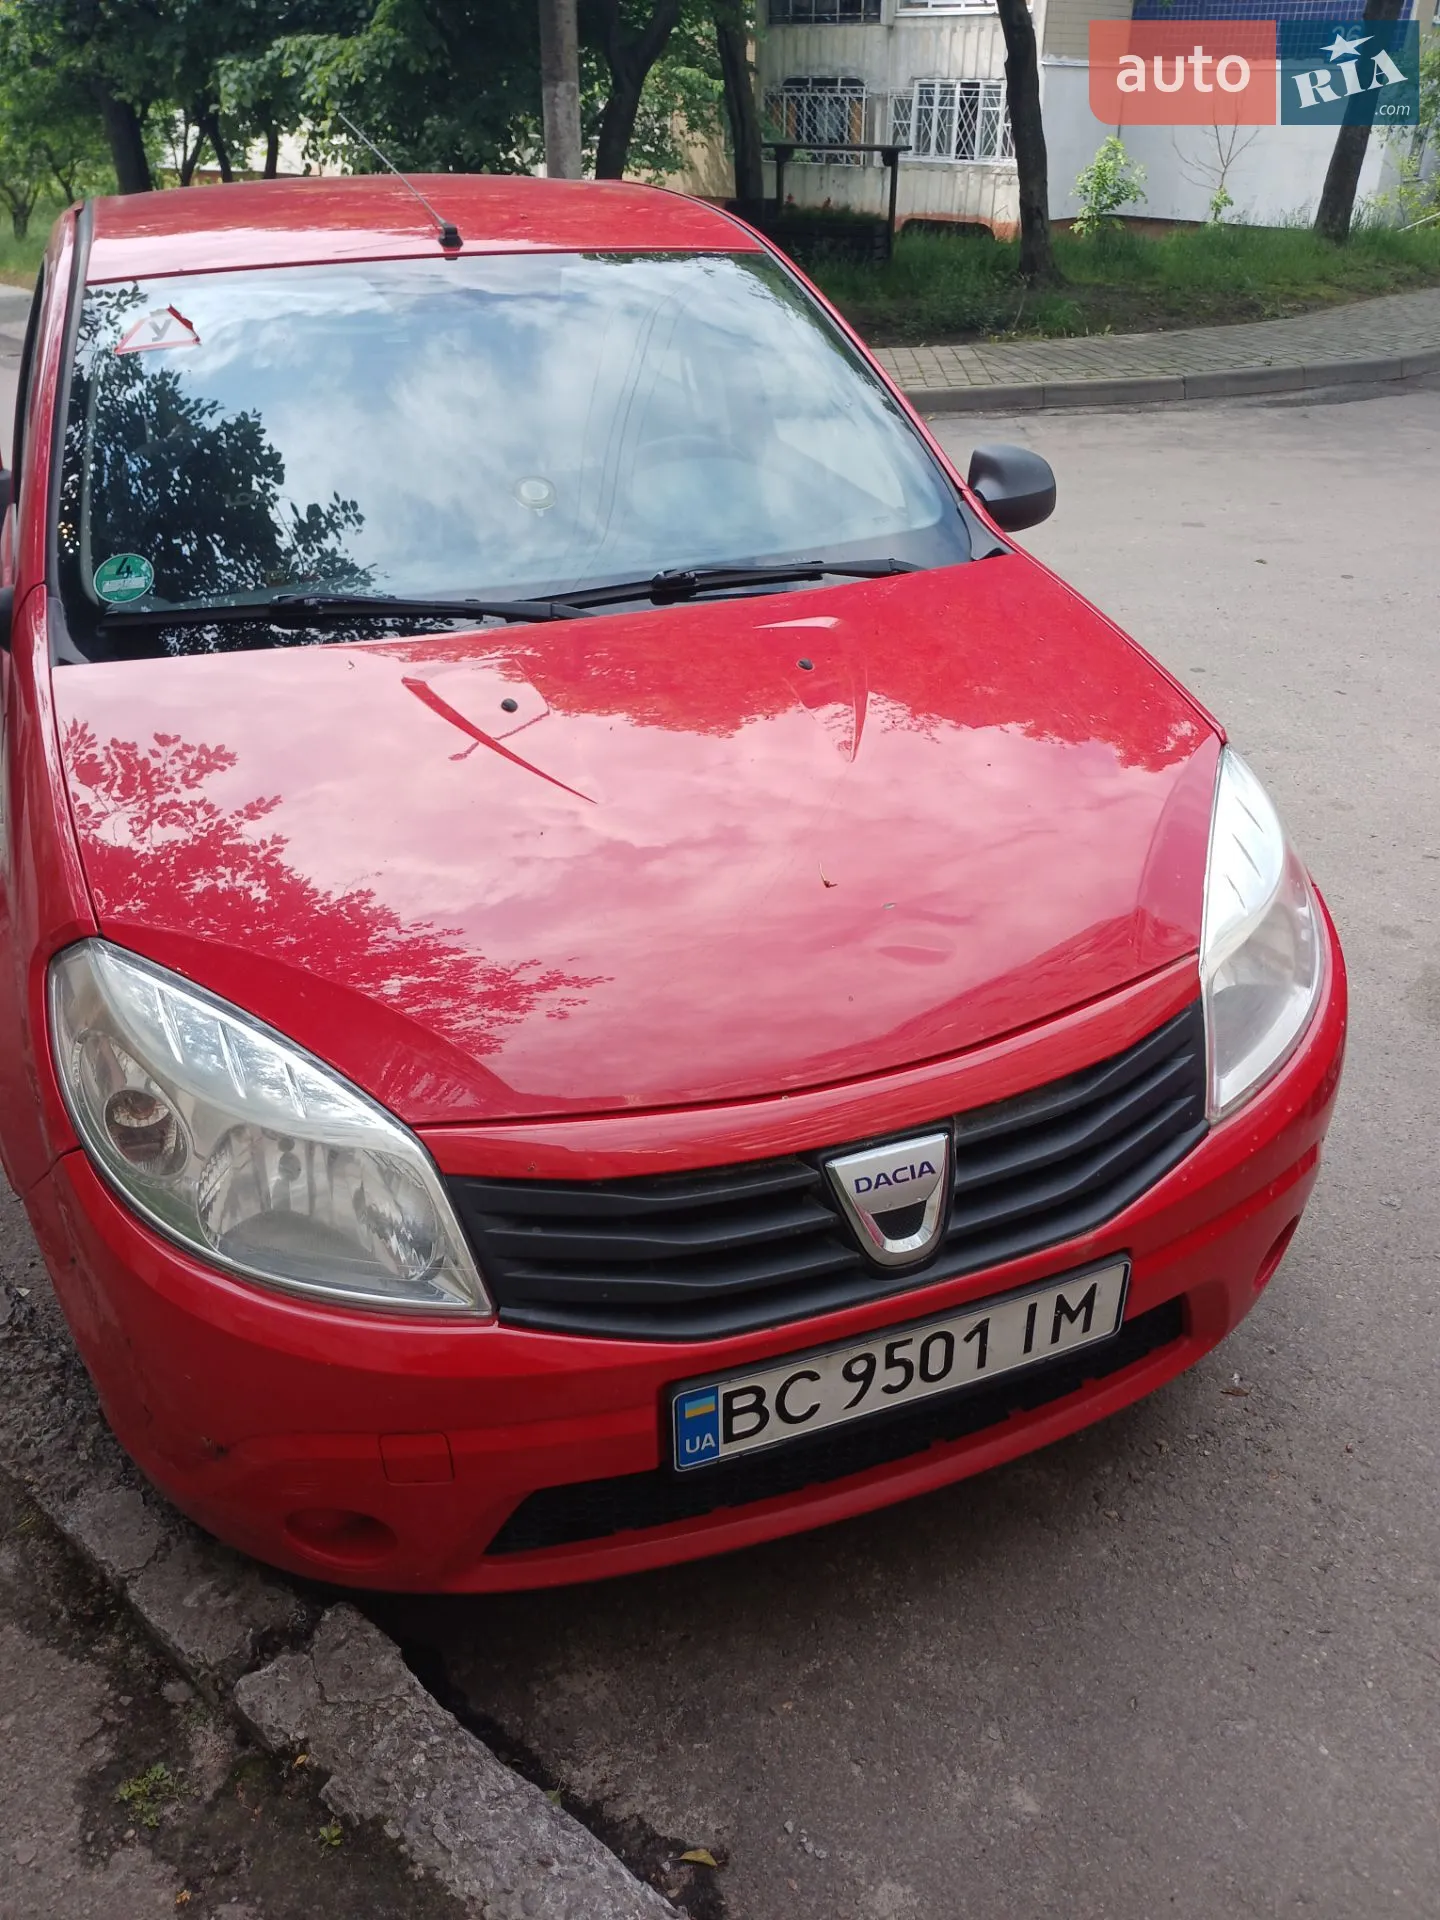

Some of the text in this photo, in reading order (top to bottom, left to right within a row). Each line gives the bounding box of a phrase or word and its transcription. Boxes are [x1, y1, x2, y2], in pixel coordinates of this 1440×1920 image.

[116, 556, 133, 580] 4
[854, 1161, 936, 1194] DACIA
[722, 1282, 1099, 1445] BC 9501 IM
[685, 1432, 716, 1455] UA
